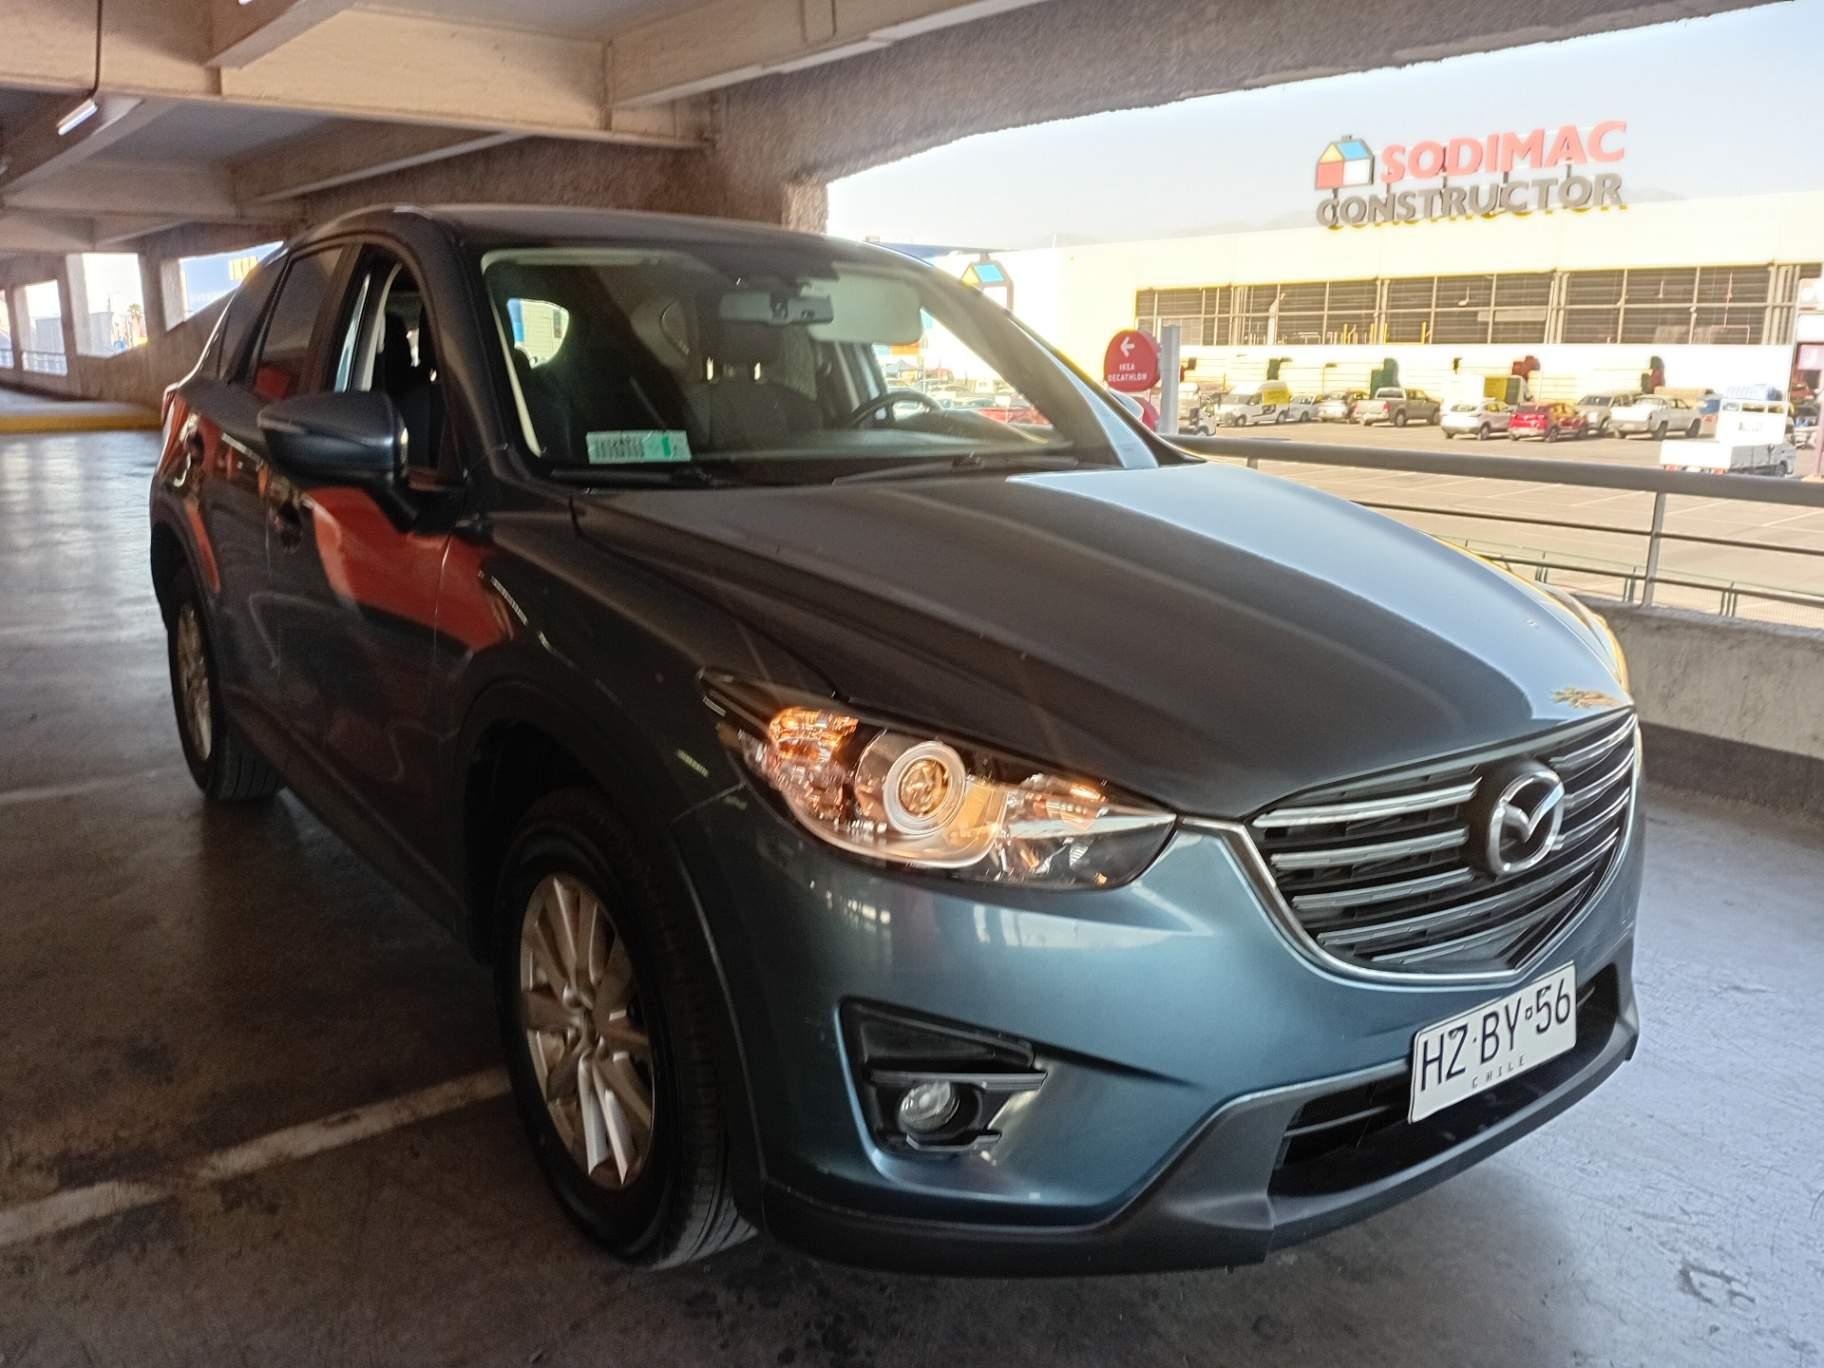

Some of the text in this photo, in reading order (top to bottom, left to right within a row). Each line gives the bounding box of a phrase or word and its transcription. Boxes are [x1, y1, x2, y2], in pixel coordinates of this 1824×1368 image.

[1380, 120, 1627, 184] SODIMAC
[1316, 172, 1623, 227] CONSTRUCTOR
[1108, 372, 1148, 382] DECATHLON
[1472, 1055, 1526, 1089] CHILE
